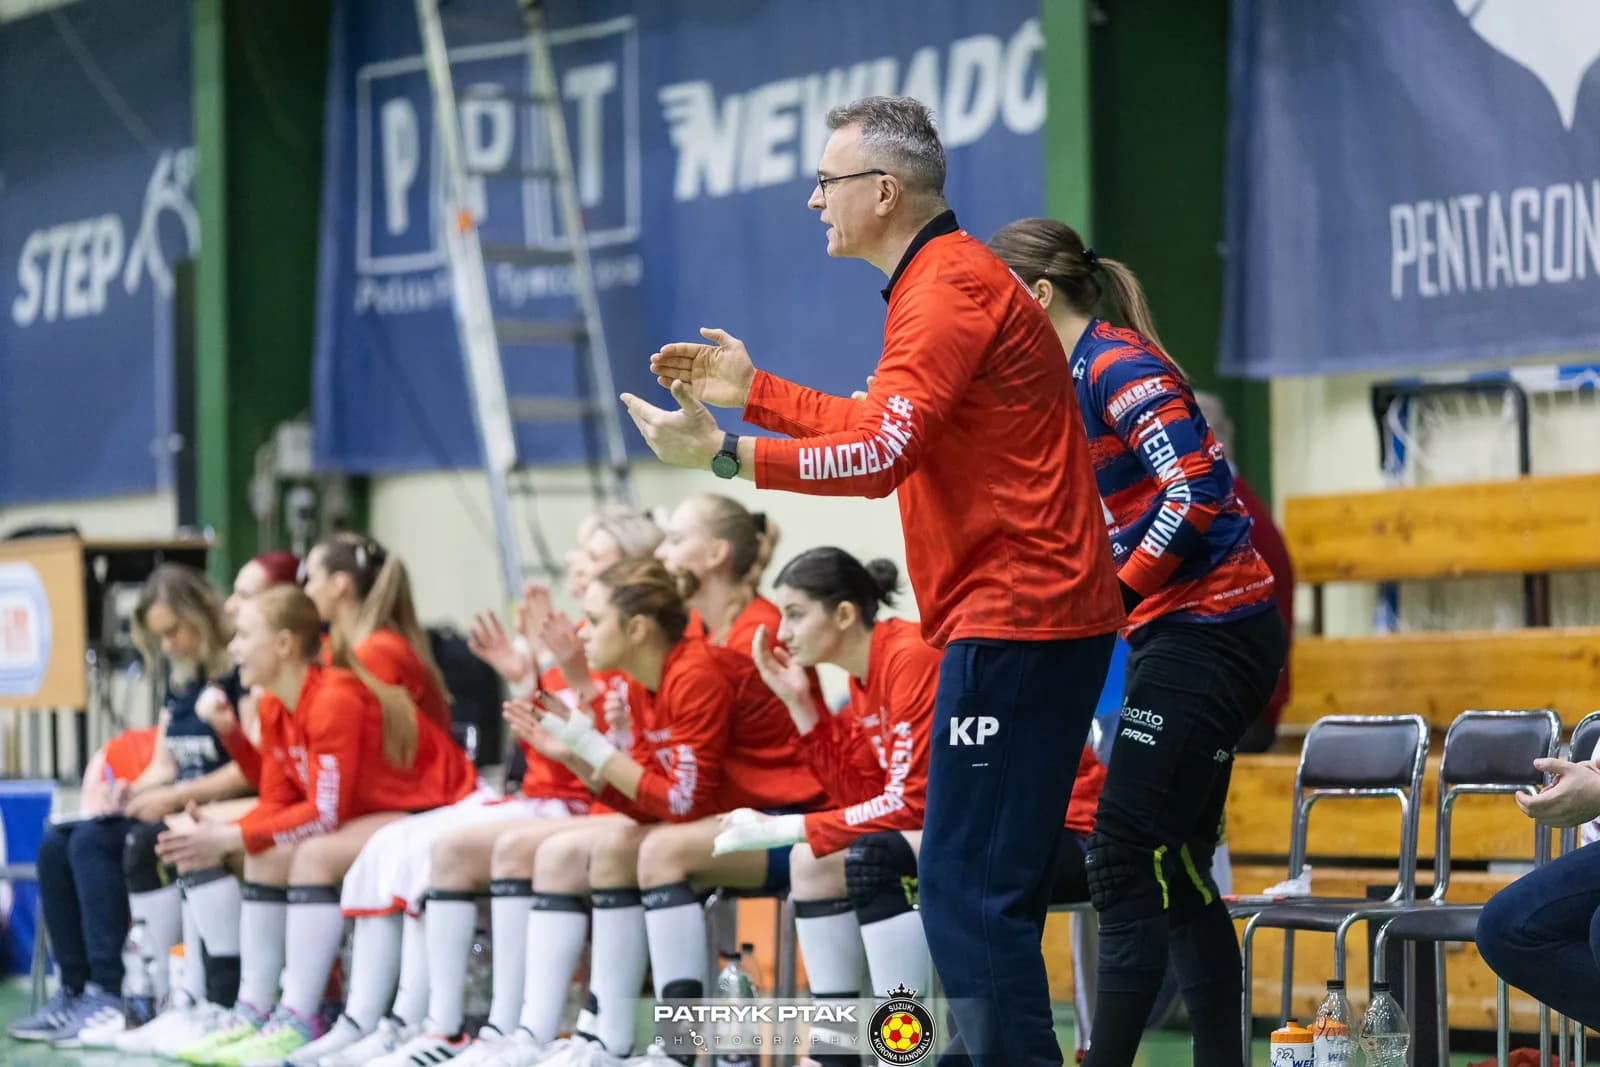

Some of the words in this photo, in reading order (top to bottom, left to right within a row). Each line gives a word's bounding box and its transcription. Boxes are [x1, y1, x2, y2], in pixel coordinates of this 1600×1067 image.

[12, 215, 122, 326] STEP
[1390, 181, 1600, 300] PENTAGON
[950, 716, 1000, 746] KP
